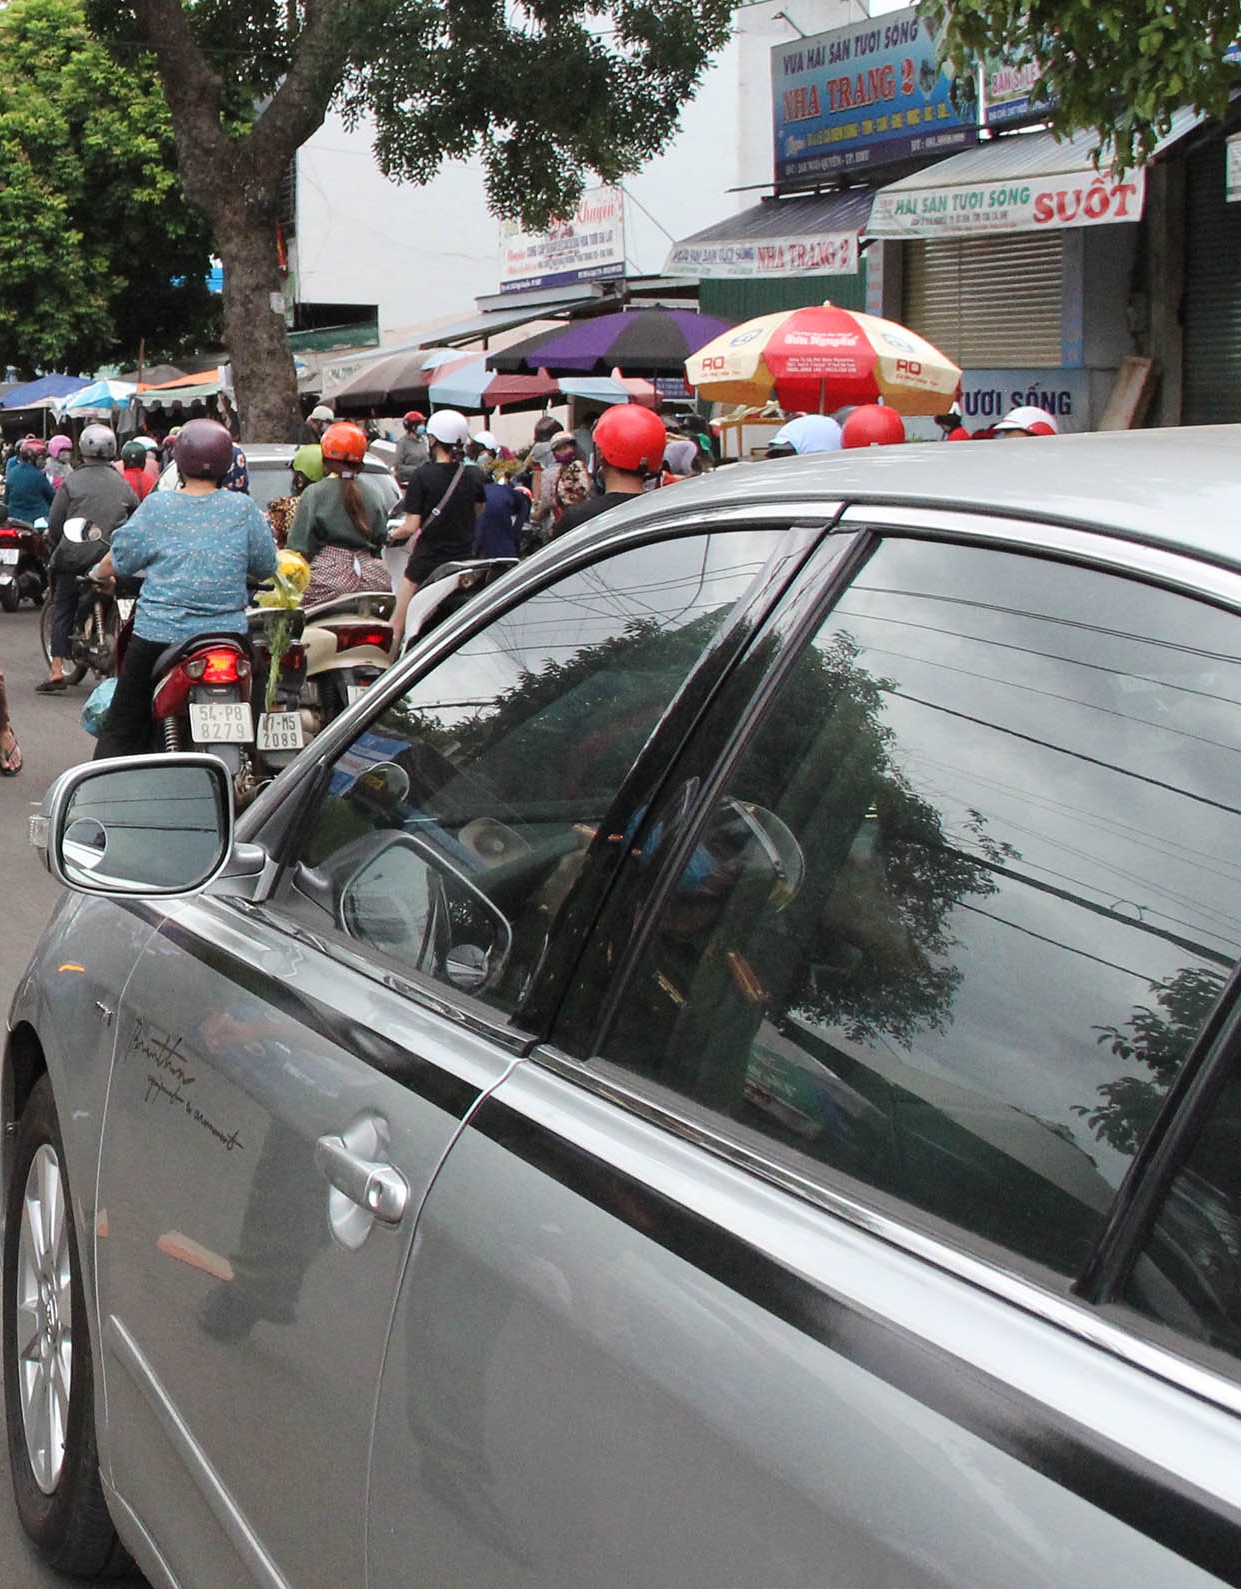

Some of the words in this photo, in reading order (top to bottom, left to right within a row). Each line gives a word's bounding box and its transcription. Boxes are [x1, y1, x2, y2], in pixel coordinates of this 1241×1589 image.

[783, 84, 820, 124] NHA
[827, 64, 896, 113] TRANG
[901, 58, 914, 95] 2
[1033, 170, 1136, 224] SUỐT
[757, 245, 785, 269] NHA
[790, 240, 836, 268] TRANG
[960, 389, 1002, 416] ƯƠI
[1010, 382, 1071, 416] SỐNG
[199, 706, 243, 721] 54-P8
[201, 723, 245, 739] 8279
[263, 732, 298, 748] 2089
